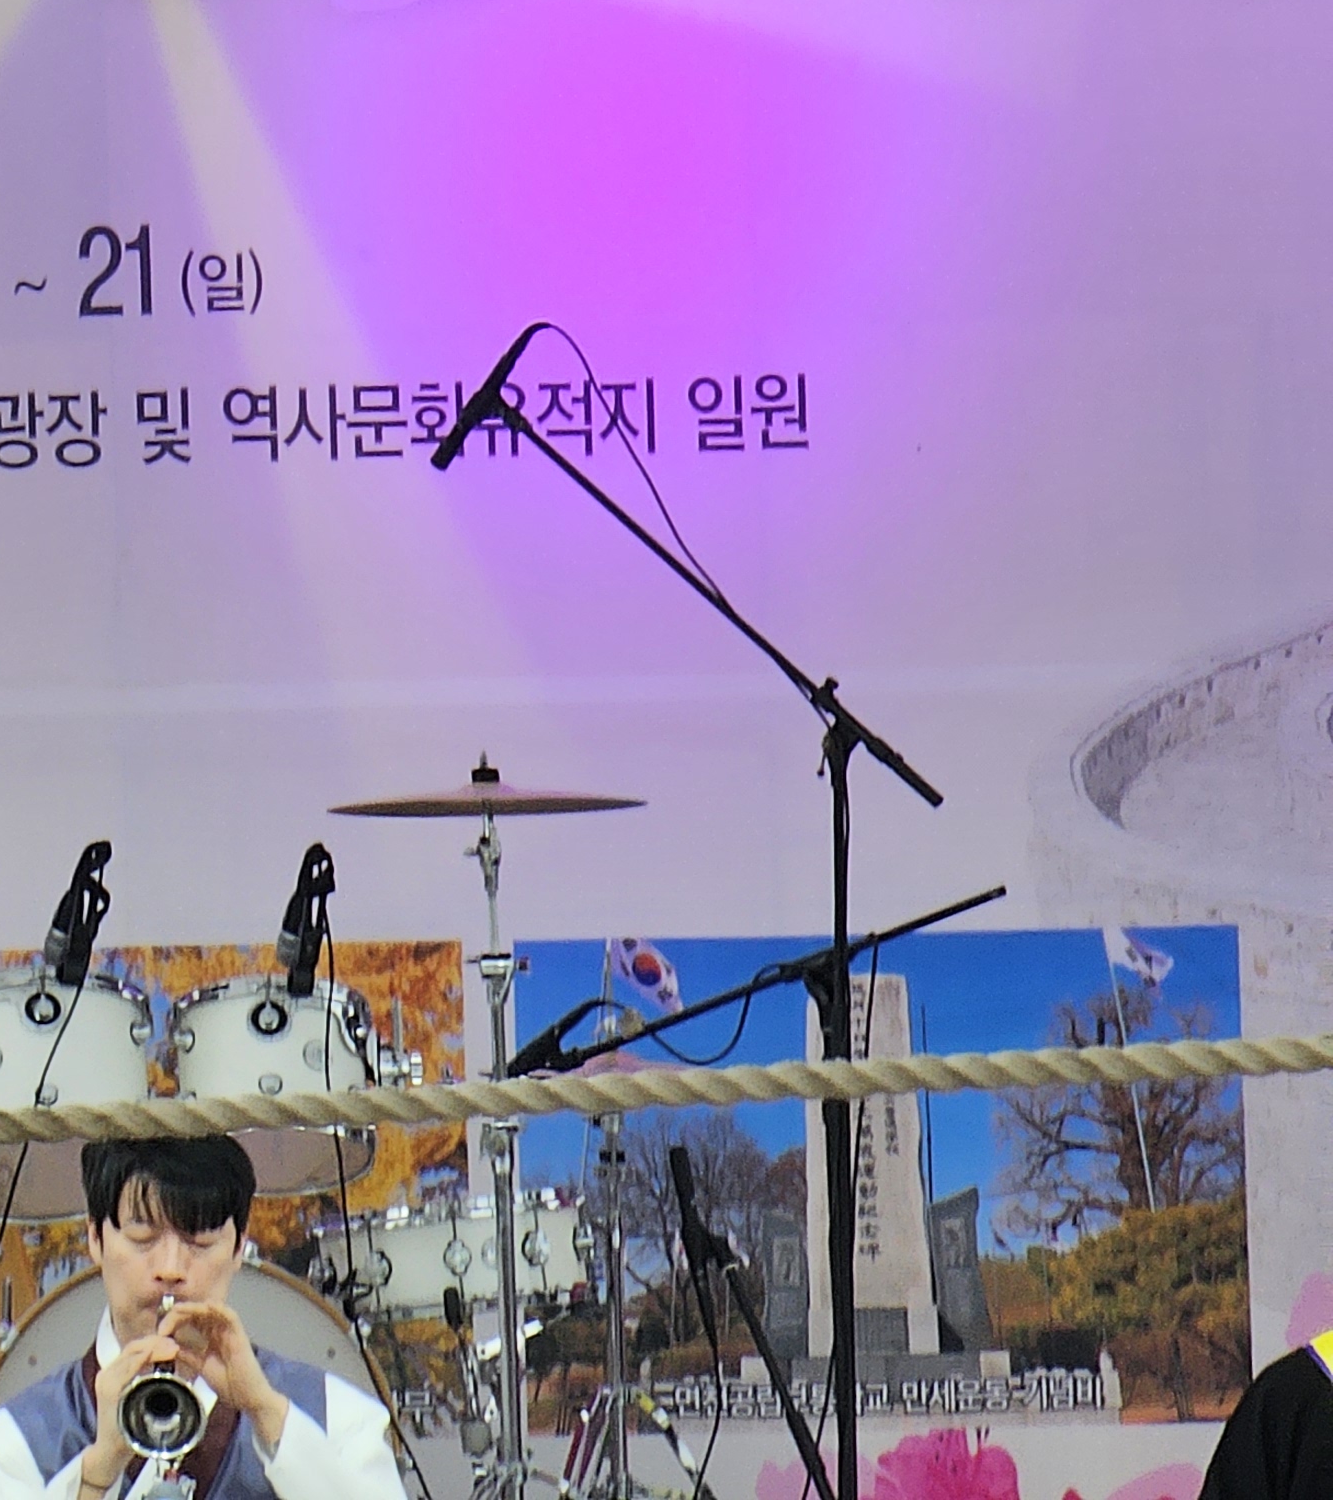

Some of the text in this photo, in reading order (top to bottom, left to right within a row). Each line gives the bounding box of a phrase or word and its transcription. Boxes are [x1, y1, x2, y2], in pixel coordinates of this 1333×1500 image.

[79, 224, 153, 317] 21
[181, 249, 263, 313] (일)
[137, 386, 192, 464] 및
[687, 373, 810, 452] 일원
